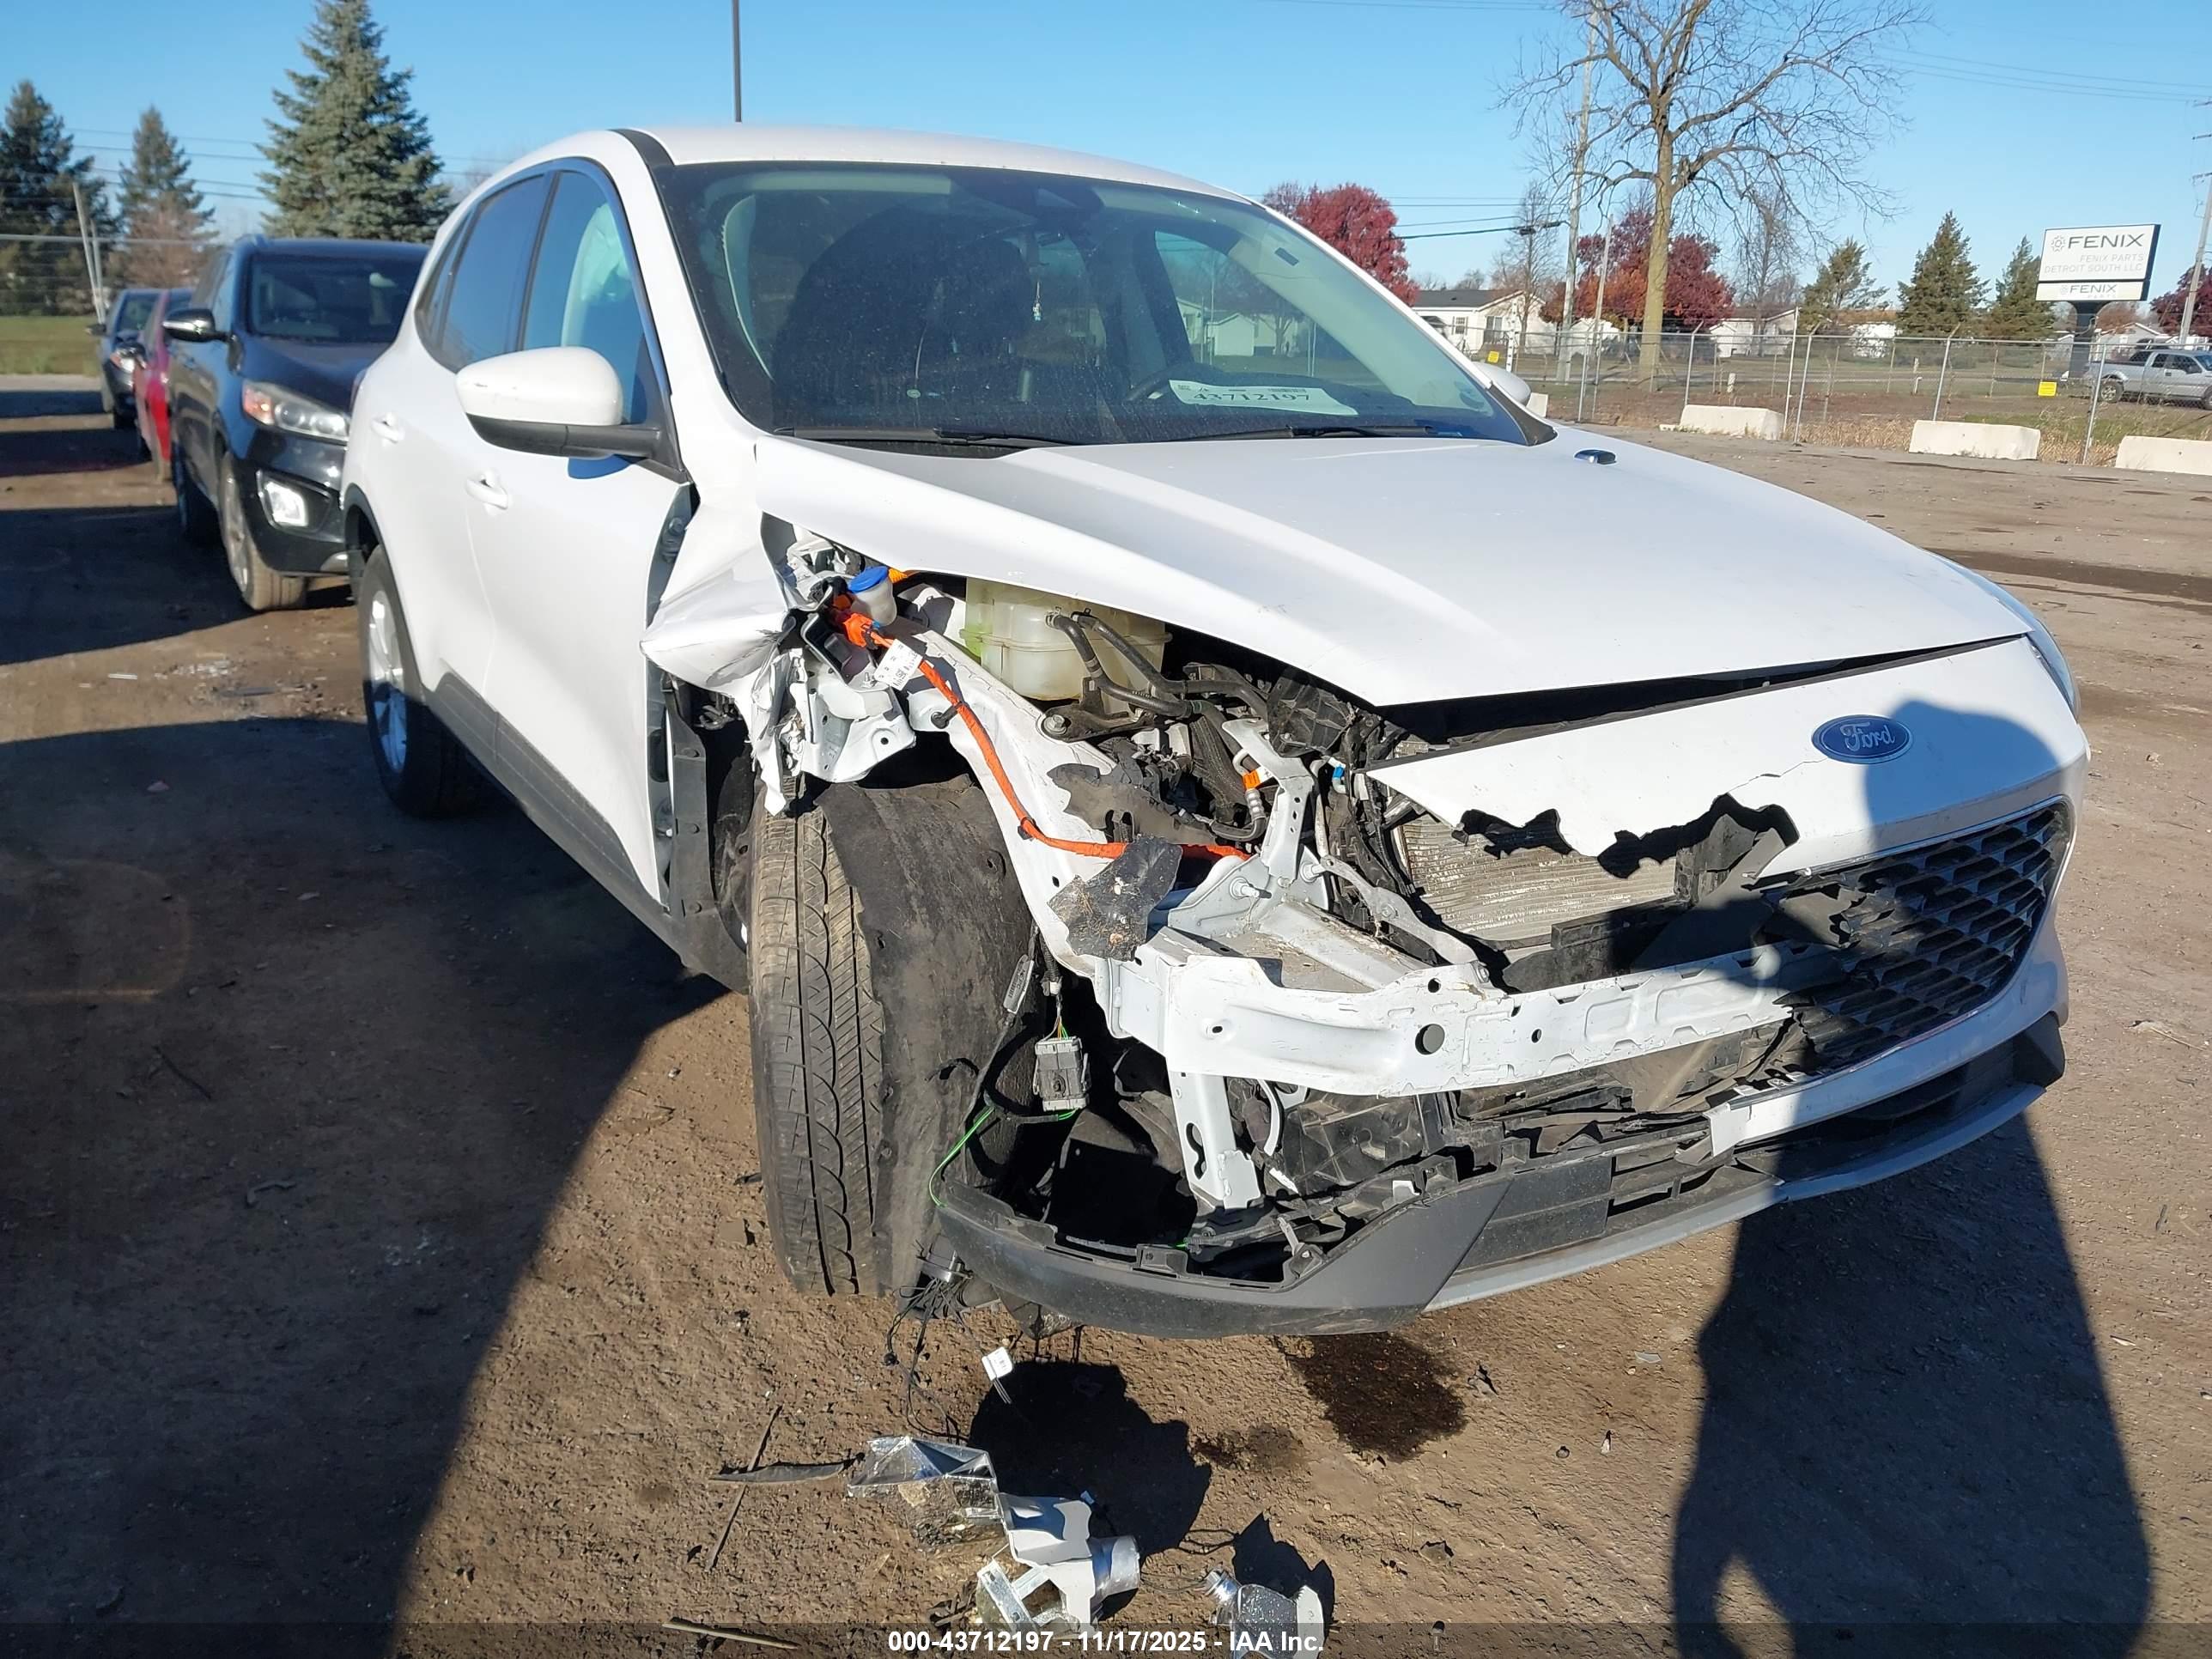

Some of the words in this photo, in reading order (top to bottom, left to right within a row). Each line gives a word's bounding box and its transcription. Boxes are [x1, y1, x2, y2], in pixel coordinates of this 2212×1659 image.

[2068, 234, 2145, 249] FENIX
[2079, 254, 2109, 263] FENIX
[2112, 253, 2144, 262] PARTS
[2044, 264, 2084, 274] DETROIT
[2087, 264, 2121, 272] SOUTH
[2124, 263, 2142, 271] LLC
[2069, 284, 2118, 294] FENIX
[1194, 392, 1310, 401] 43712197
[1839, 721, 1896, 752] Ford
